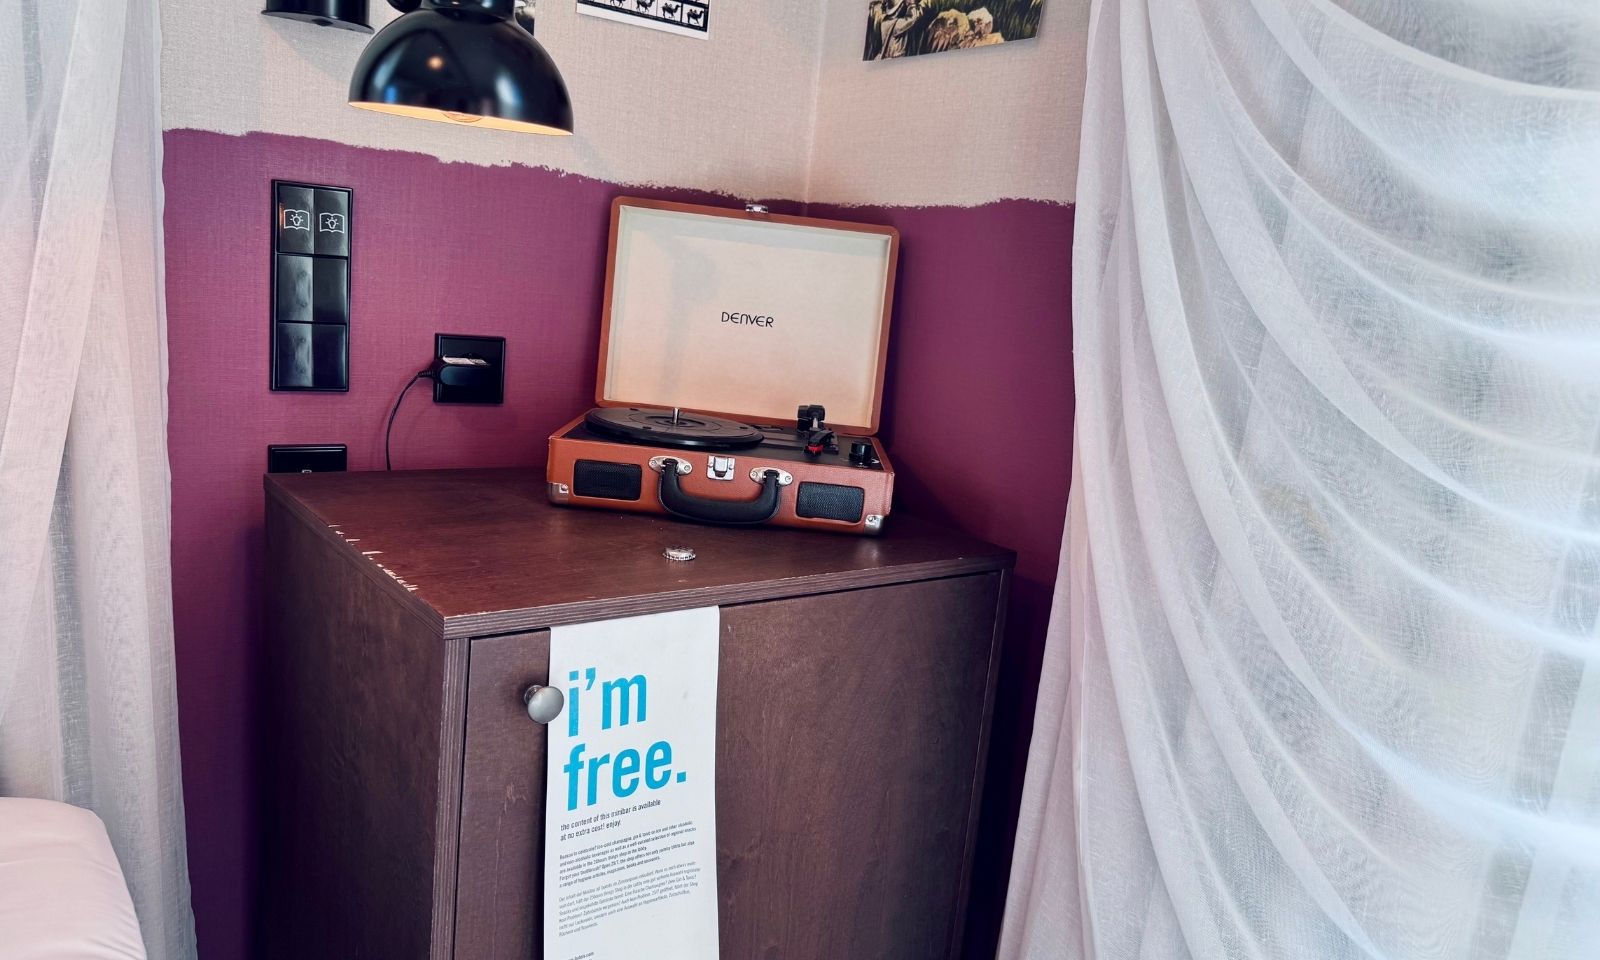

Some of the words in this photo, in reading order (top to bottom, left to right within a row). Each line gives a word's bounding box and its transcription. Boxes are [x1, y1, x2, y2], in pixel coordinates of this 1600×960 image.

[721, 311, 774, 328] DENVER
[568, 667, 647, 737] i'm
[563, 741, 687, 811] free.
[561, 823, 569, 832] the
[571, 817, 592, 829] content
[600, 812, 610, 820] this
[638, 799, 661, 810] available
[576, 828, 590, 837] extra
[592, 823, 605, 832] cost!
